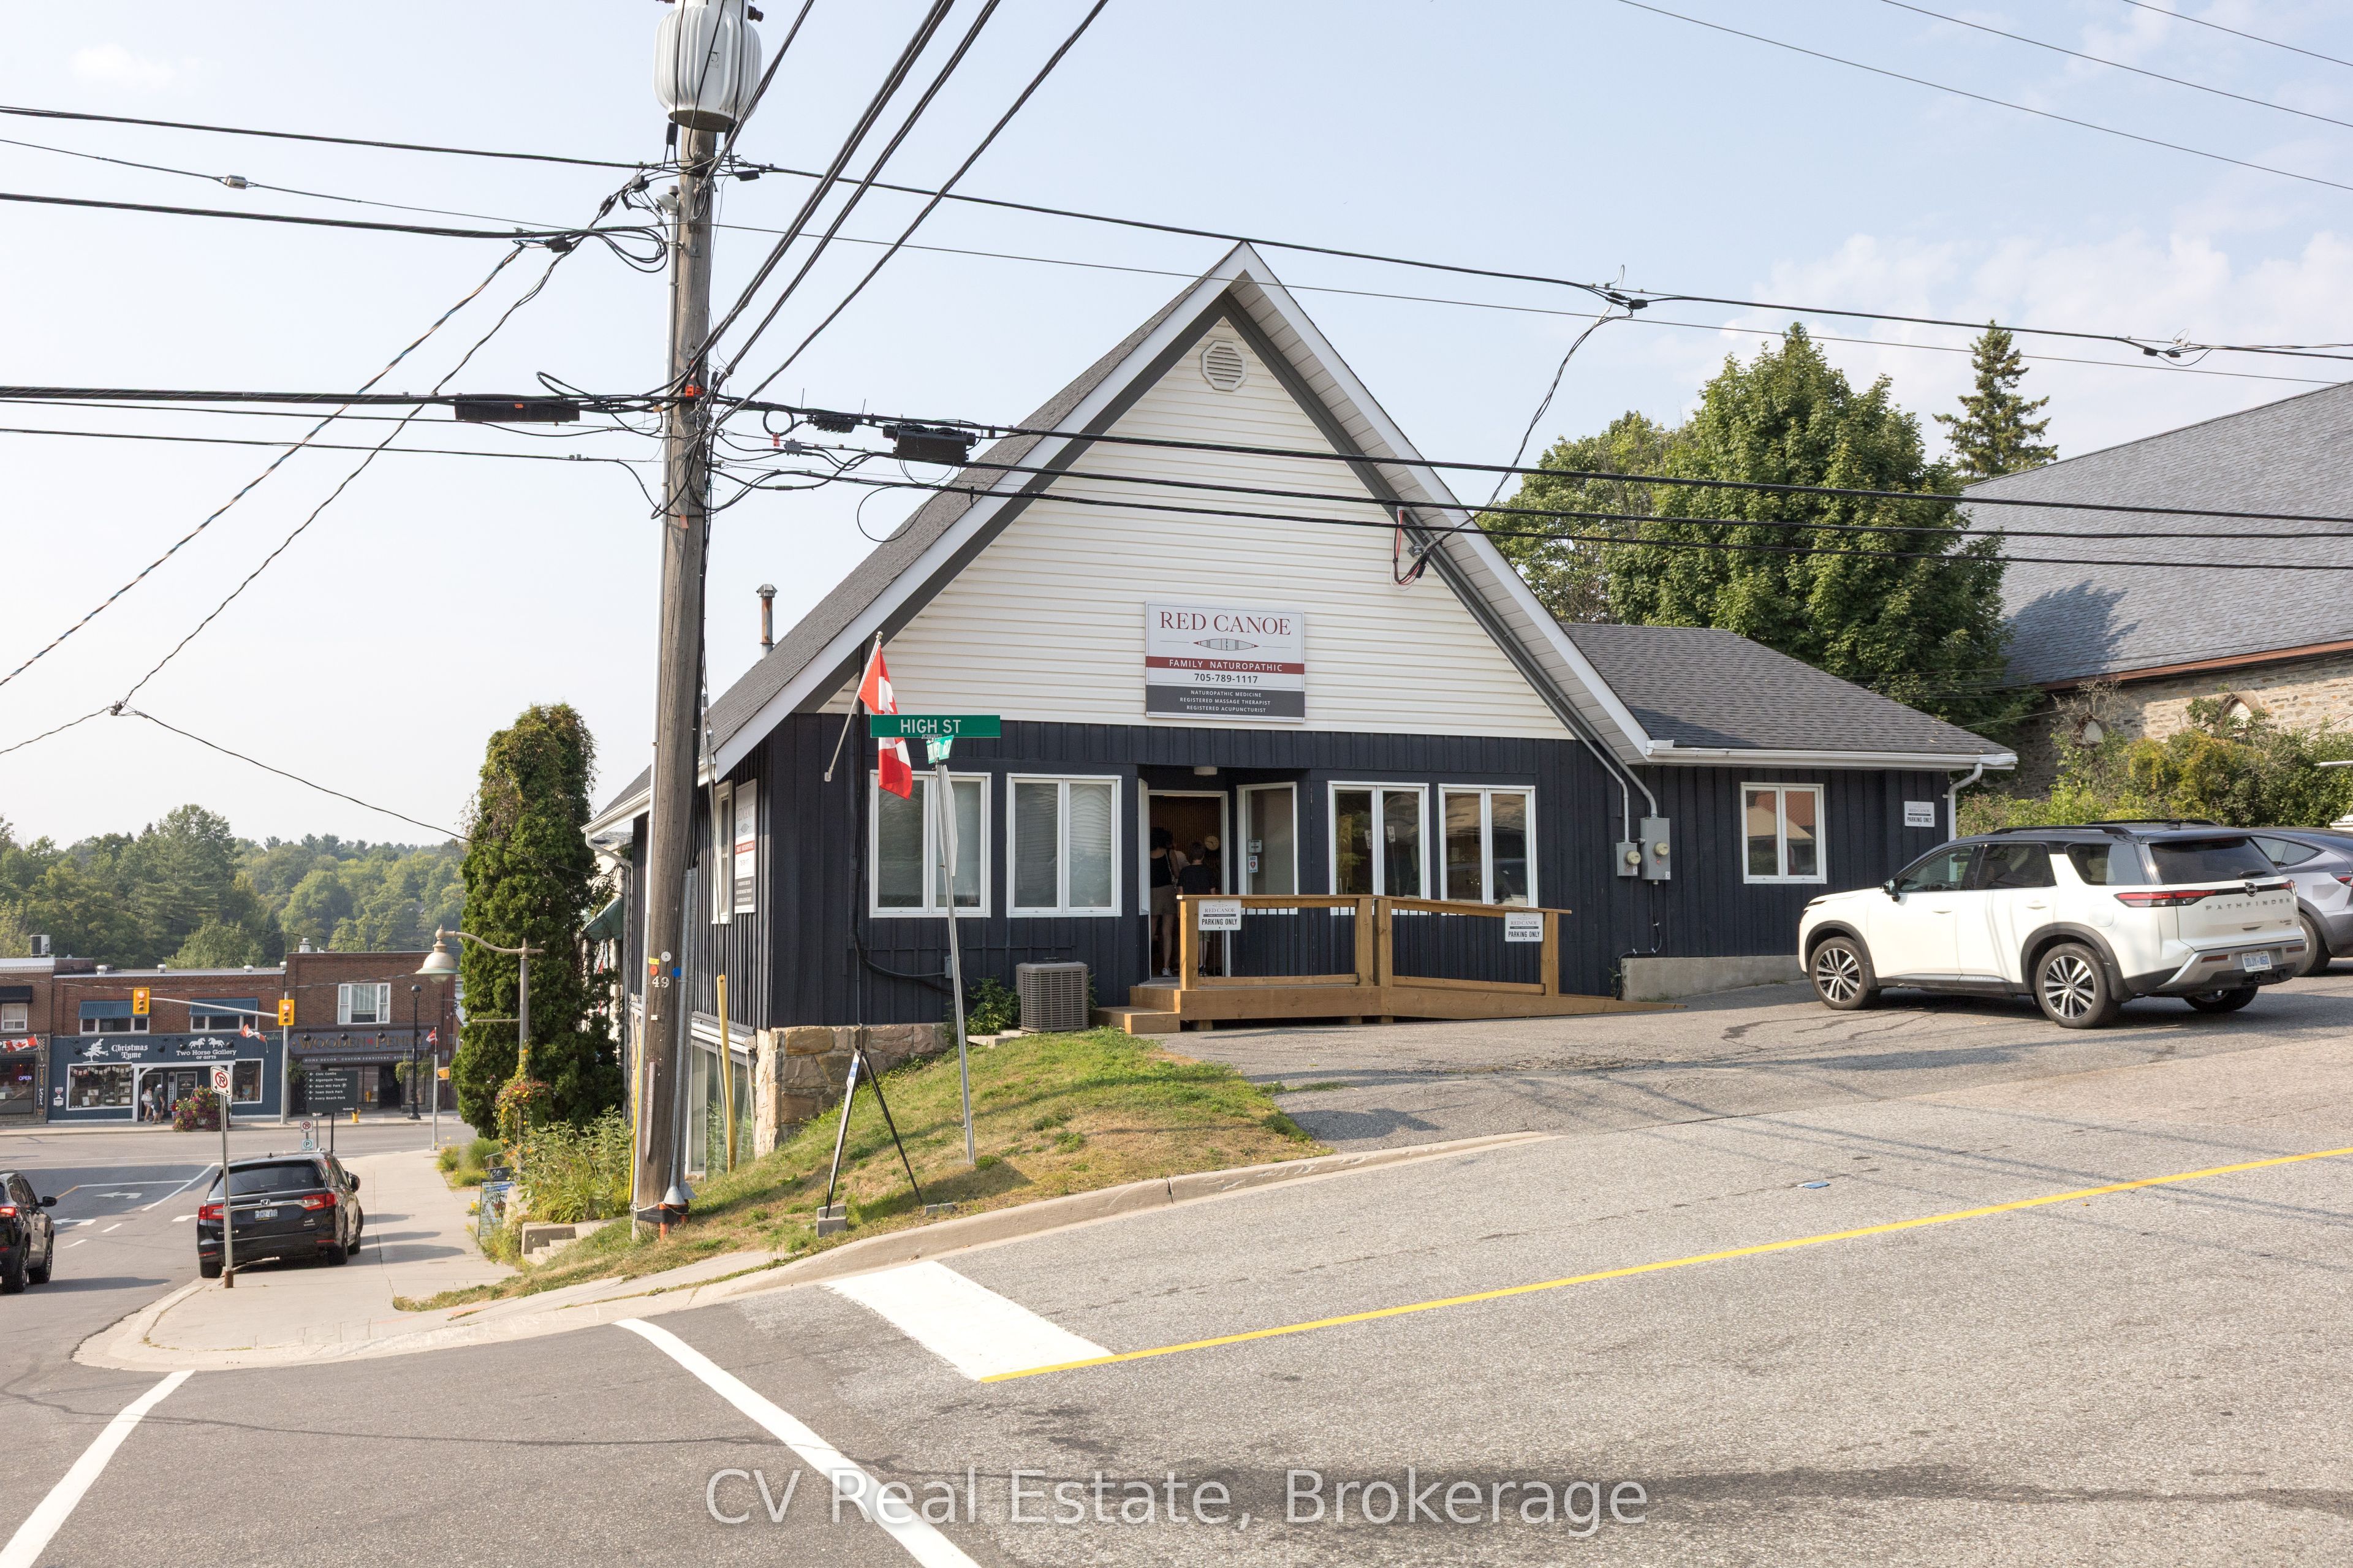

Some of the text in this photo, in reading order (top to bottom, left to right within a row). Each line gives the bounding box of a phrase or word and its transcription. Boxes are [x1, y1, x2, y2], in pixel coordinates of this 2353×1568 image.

[1160, 612, 1291, 635] RED CANOE
[1169, 659, 1283, 672] FAMILY NATUROPATHIC
[1194, 673, 1258, 684] 705-789-1117
[900, 719, 961, 733] HIGH ST
[942, 739, 952, 756] RD
[2205, 898, 2290, 911] PATHFINDER
[652, 975, 670, 988] 49
[298, 1034, 426, 1050] WOODEN PENNY
